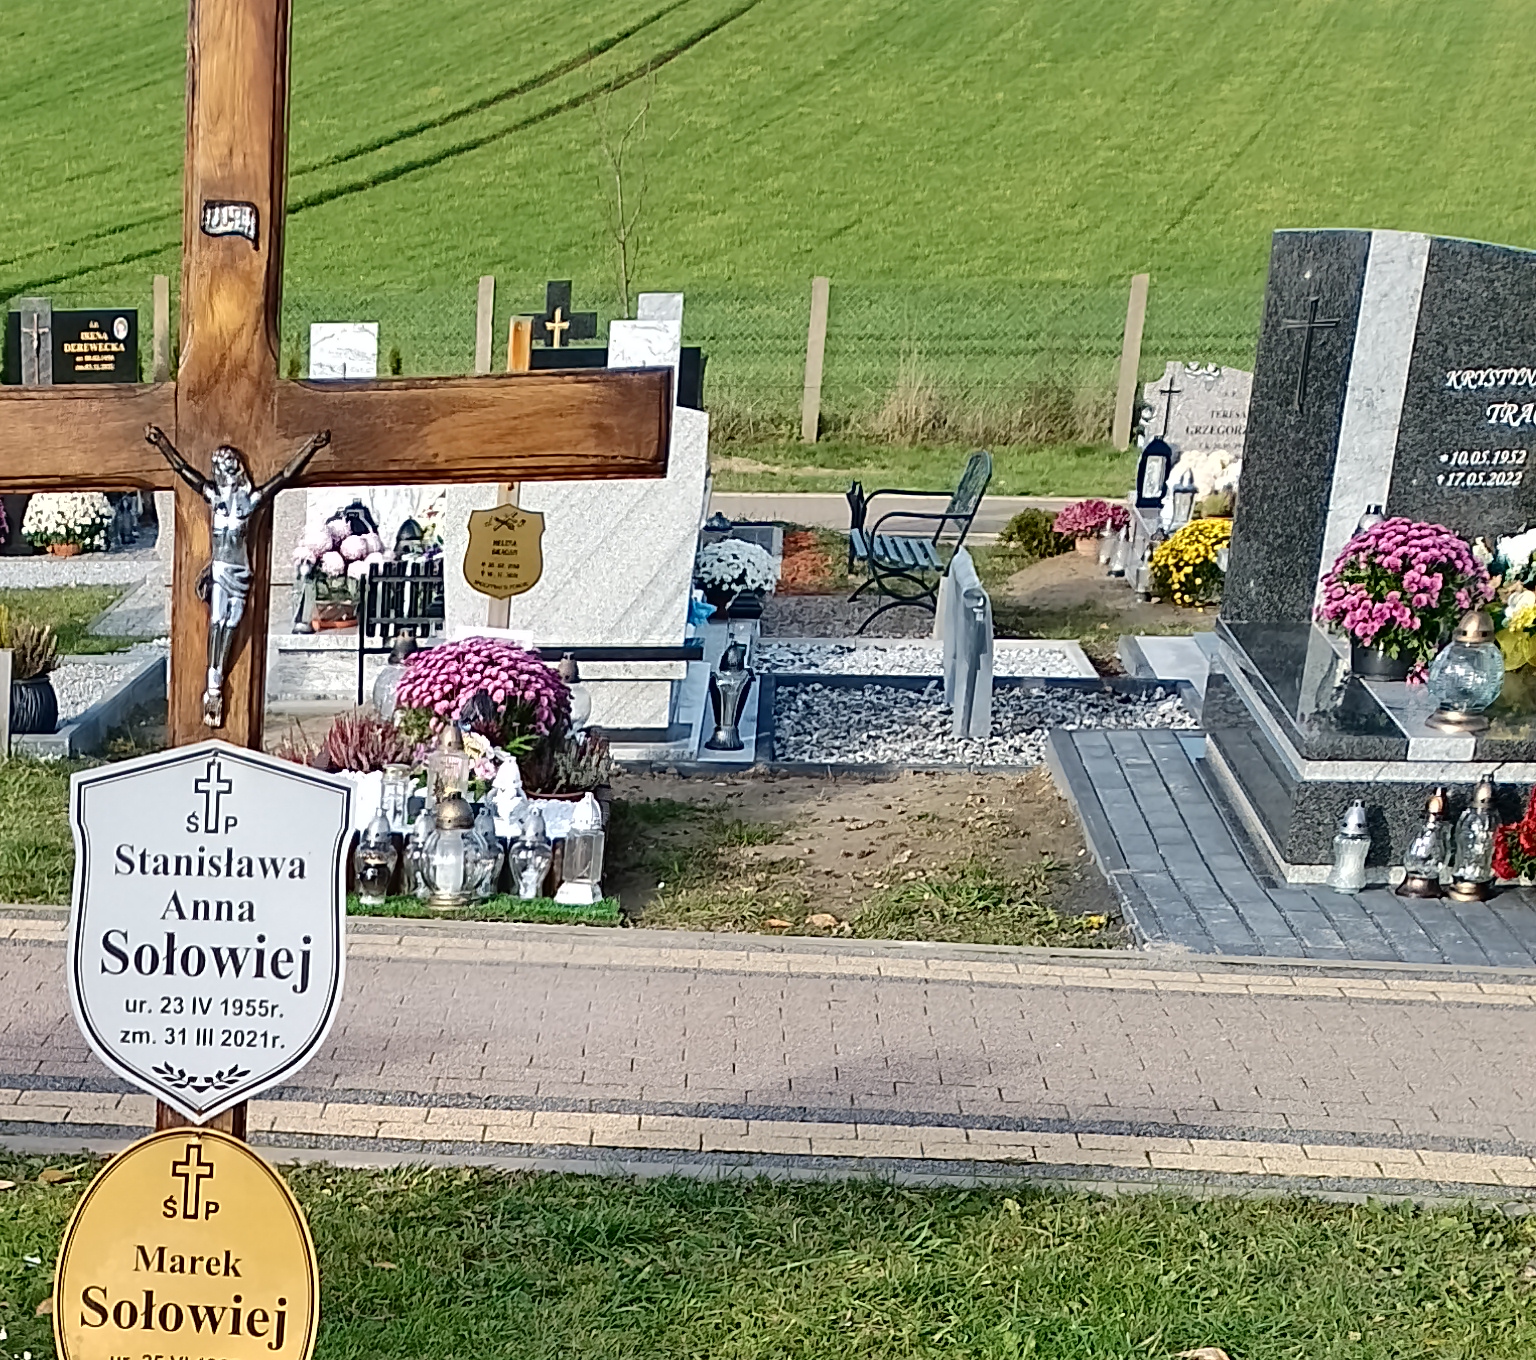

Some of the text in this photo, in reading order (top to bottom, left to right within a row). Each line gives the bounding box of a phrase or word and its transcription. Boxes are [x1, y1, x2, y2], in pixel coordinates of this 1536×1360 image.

[1450, 450, 1527, 466] 10.05.1952
[1446, 472, 1523, 487] 17.05.2022
[186, 811, 238, 834] Ś P
[114, 843, 306, 880] Stanisława
[160, 889, 256, 922] Anna
[100, 928, 312, 994] Sołowiej
[125, 997, 284, 1018] ur. 23 IV 1955r.
[120, 1027, 286, 1050] zm. 31 III 2021r.
[162, 1195, 220, 1221] Ś P
[133, 1244, 243, 1278] Marek
[80, 1285, 287, 1351] Sołowiej
